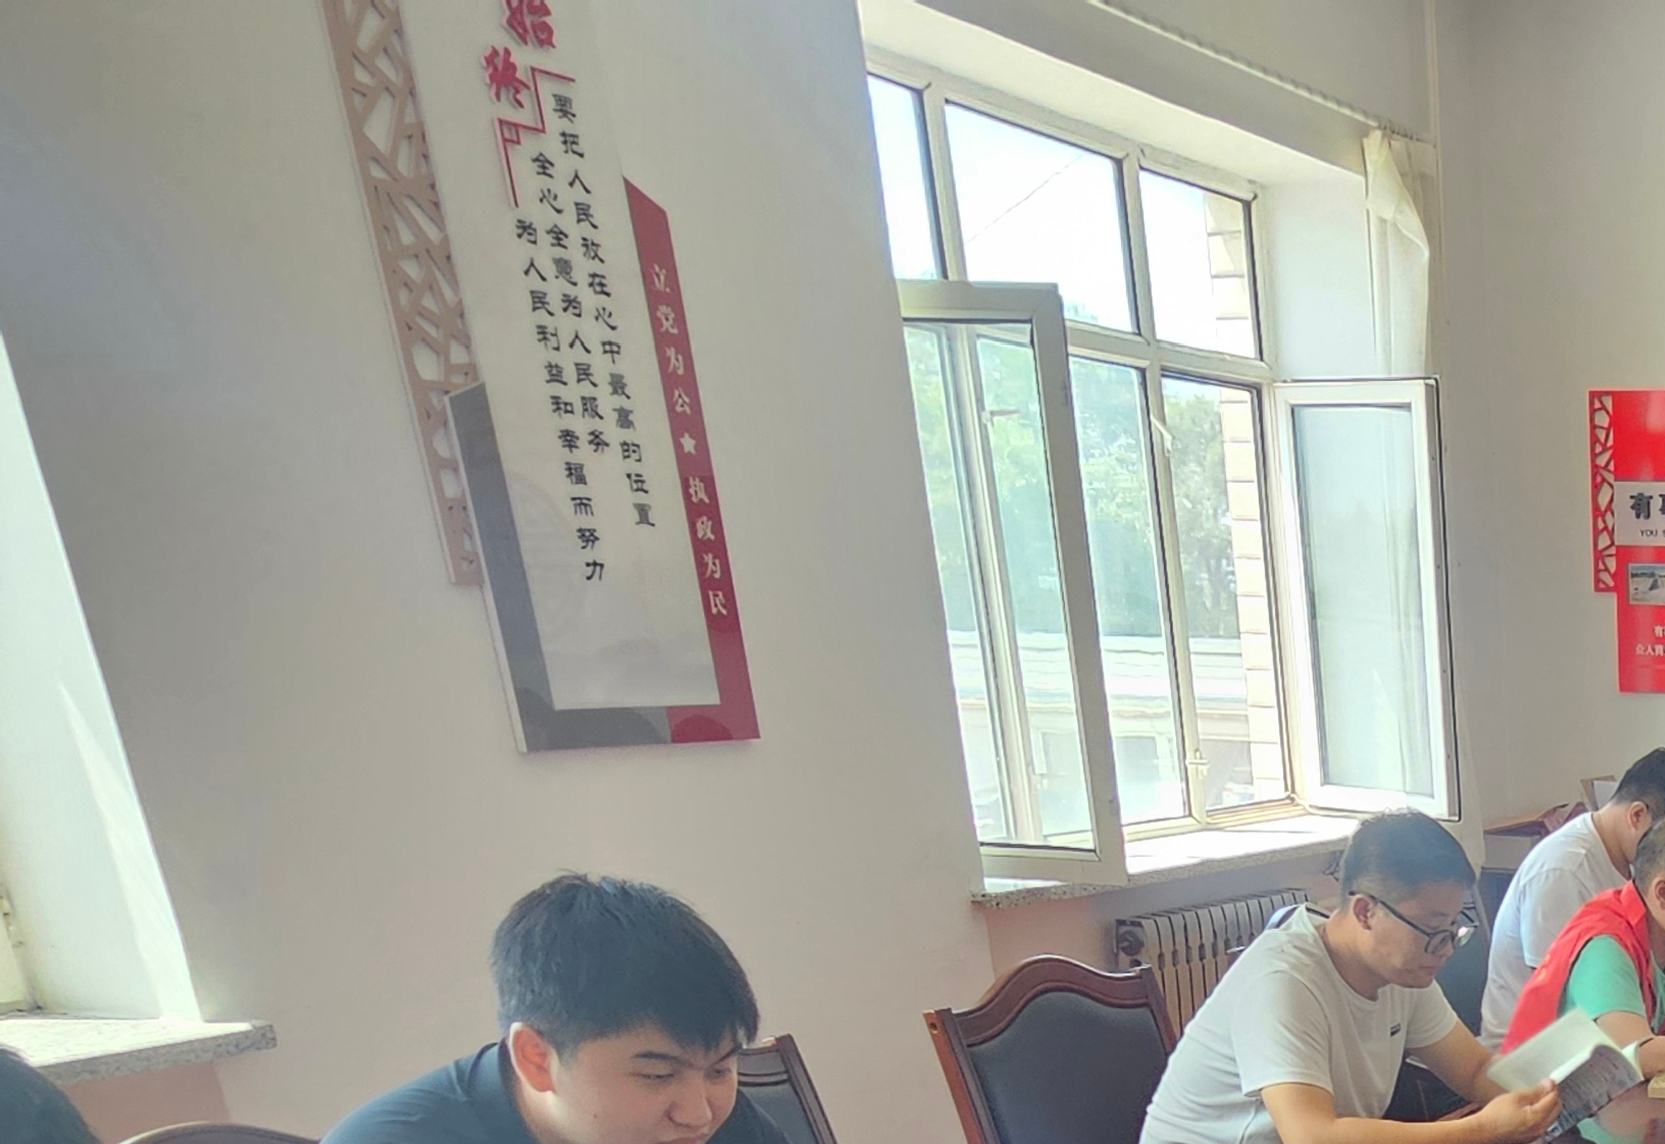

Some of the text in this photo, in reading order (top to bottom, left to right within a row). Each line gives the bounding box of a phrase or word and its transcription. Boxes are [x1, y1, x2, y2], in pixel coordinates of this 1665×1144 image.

[515, 219, 604, 581] 为人民利益和幸福而努力
[531, 152, 609, 454] 全心全意为人民服务
[552, 93, 655, 528] 要把人民放在心中最高的位置
[650, 263, 728, 617] 立党为公 执政为民
[1640, 529, 1658, 538] YOU
